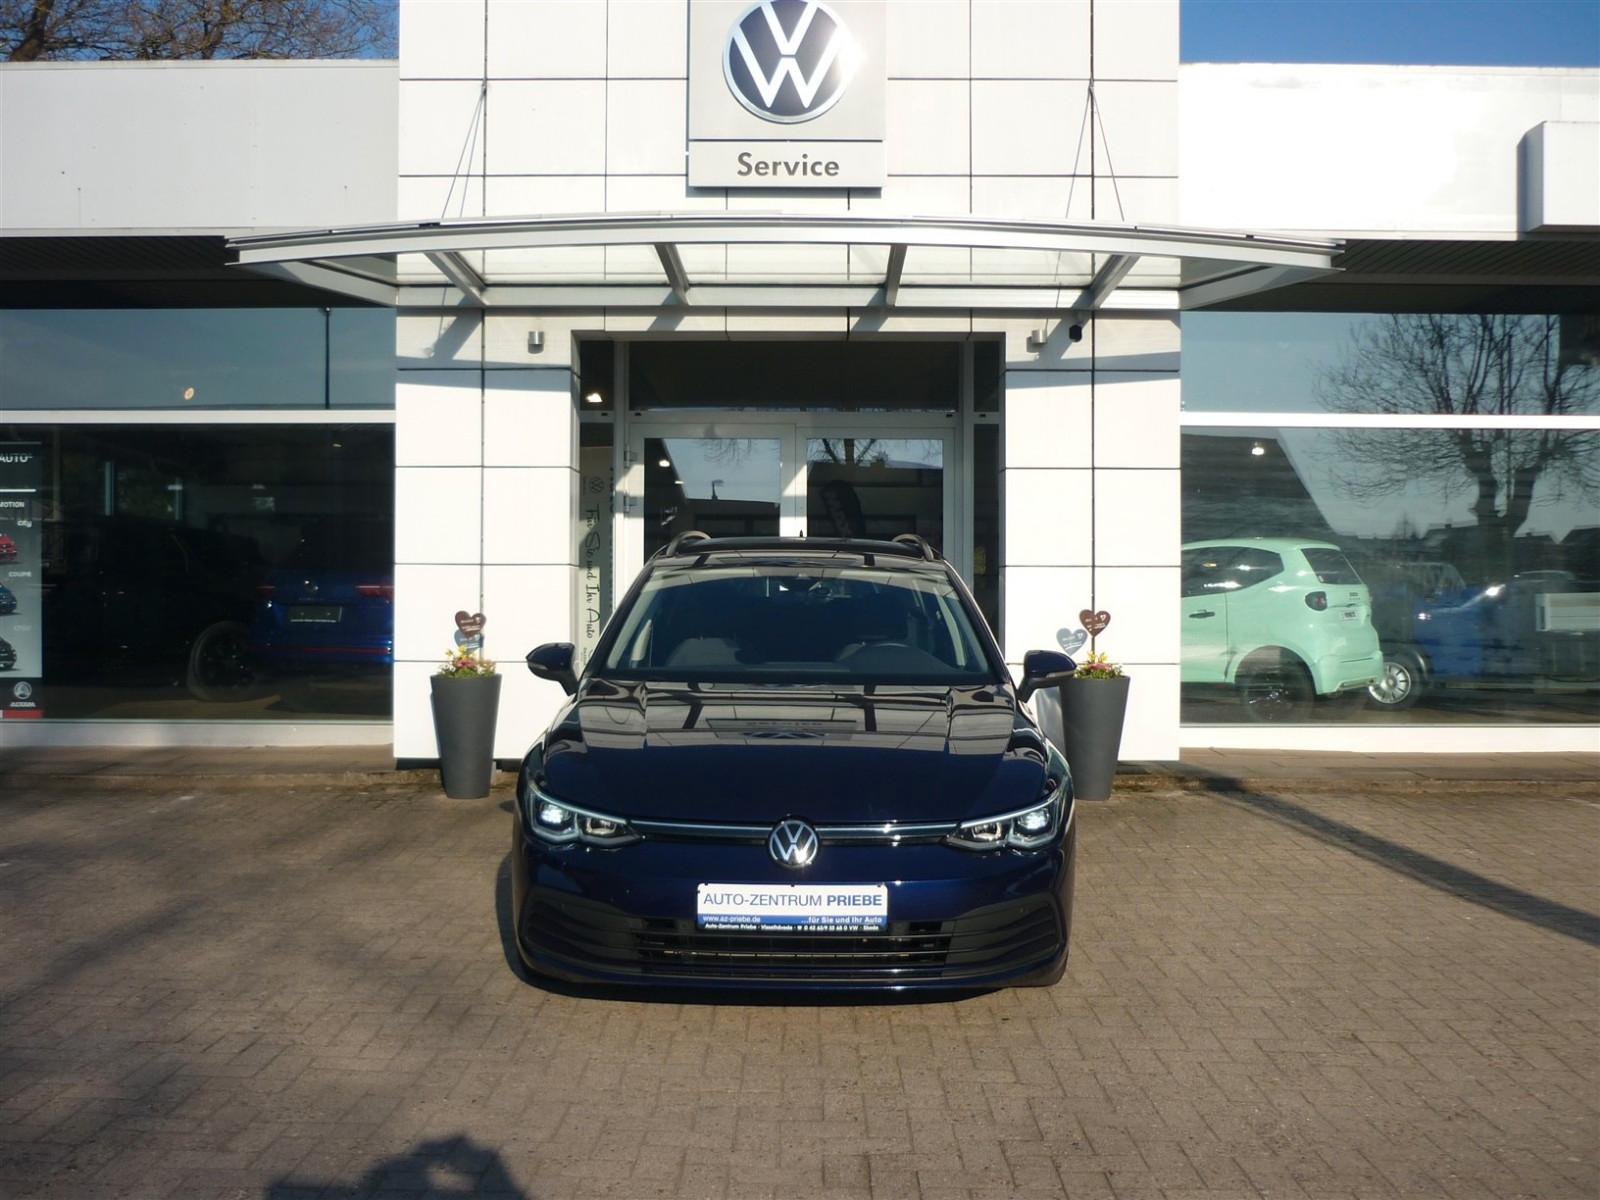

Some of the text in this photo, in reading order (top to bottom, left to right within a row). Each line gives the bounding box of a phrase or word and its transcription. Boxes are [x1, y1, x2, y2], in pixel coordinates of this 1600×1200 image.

[730, 0, 843, 109] VW
[737, 152, 839, 176] Service
[585, 583, 601, 603] Ihr
[585, 608, 601, 639] Auto
[771, 820, 816, 865] VW
[703, 893, 883, 906] AUTO-ZENTRUM PRIEBE
[703, 915, 761, 923] www.az-priebe.de
